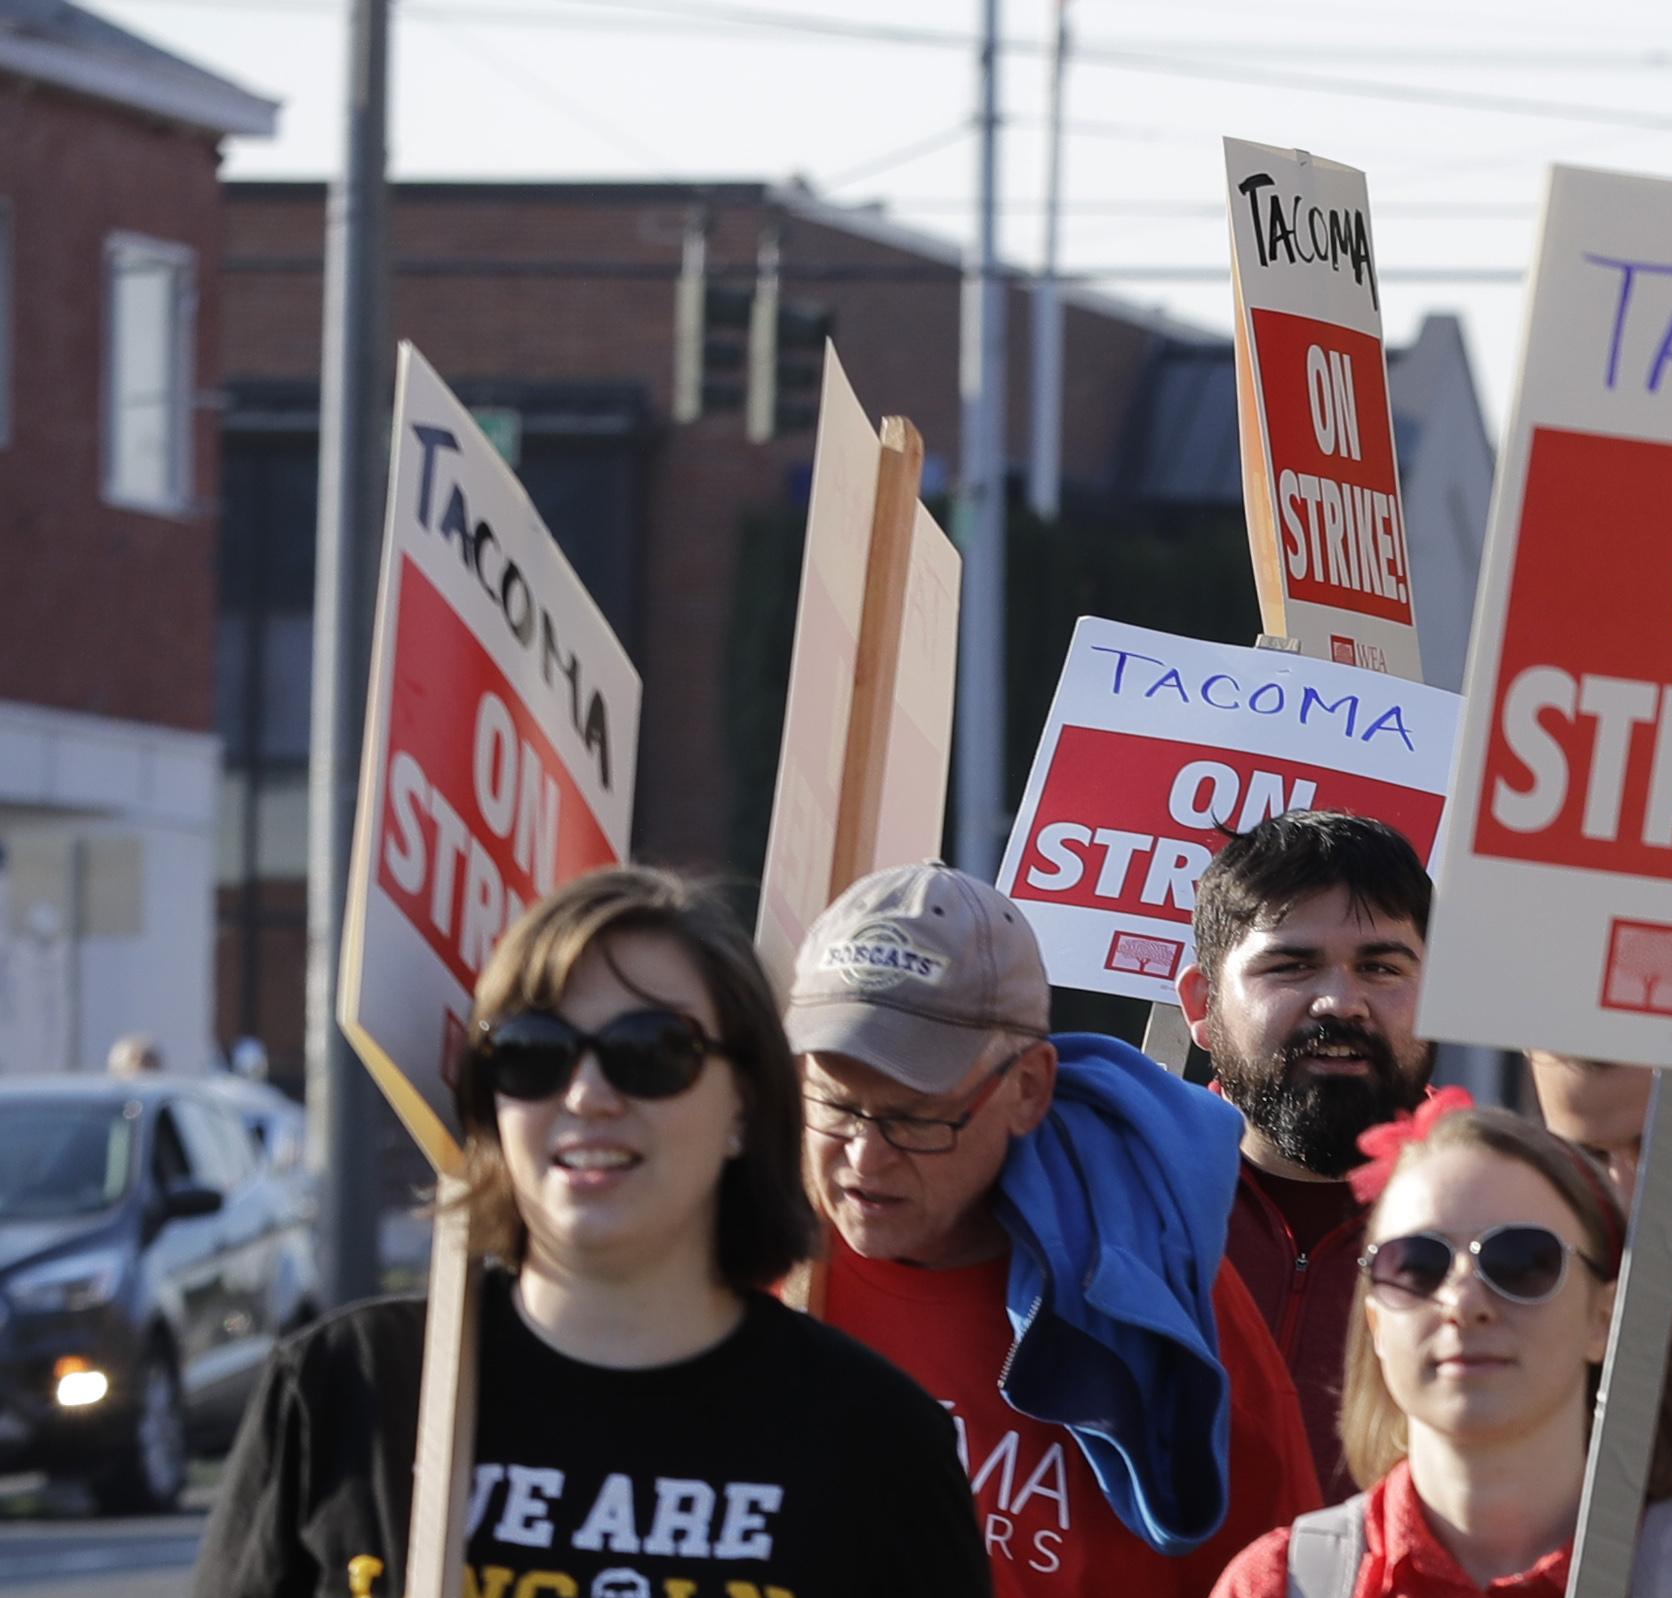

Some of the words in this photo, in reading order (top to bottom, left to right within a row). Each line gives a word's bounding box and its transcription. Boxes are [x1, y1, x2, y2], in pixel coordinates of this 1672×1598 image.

[1239, 172, 1379, 312] TACOMA
[1306, 343, 1362, 462] ON
[1278, 468, 1408, 605] STRIKE!
[412, 422, 612, 792] TACOMA
[1090, 645, 1416, 752] TACOMA
[473, 691, 560, 896] ON
[1168, 760, 1318, 834] ON
[571, 1472, 784, 1561] ARE
